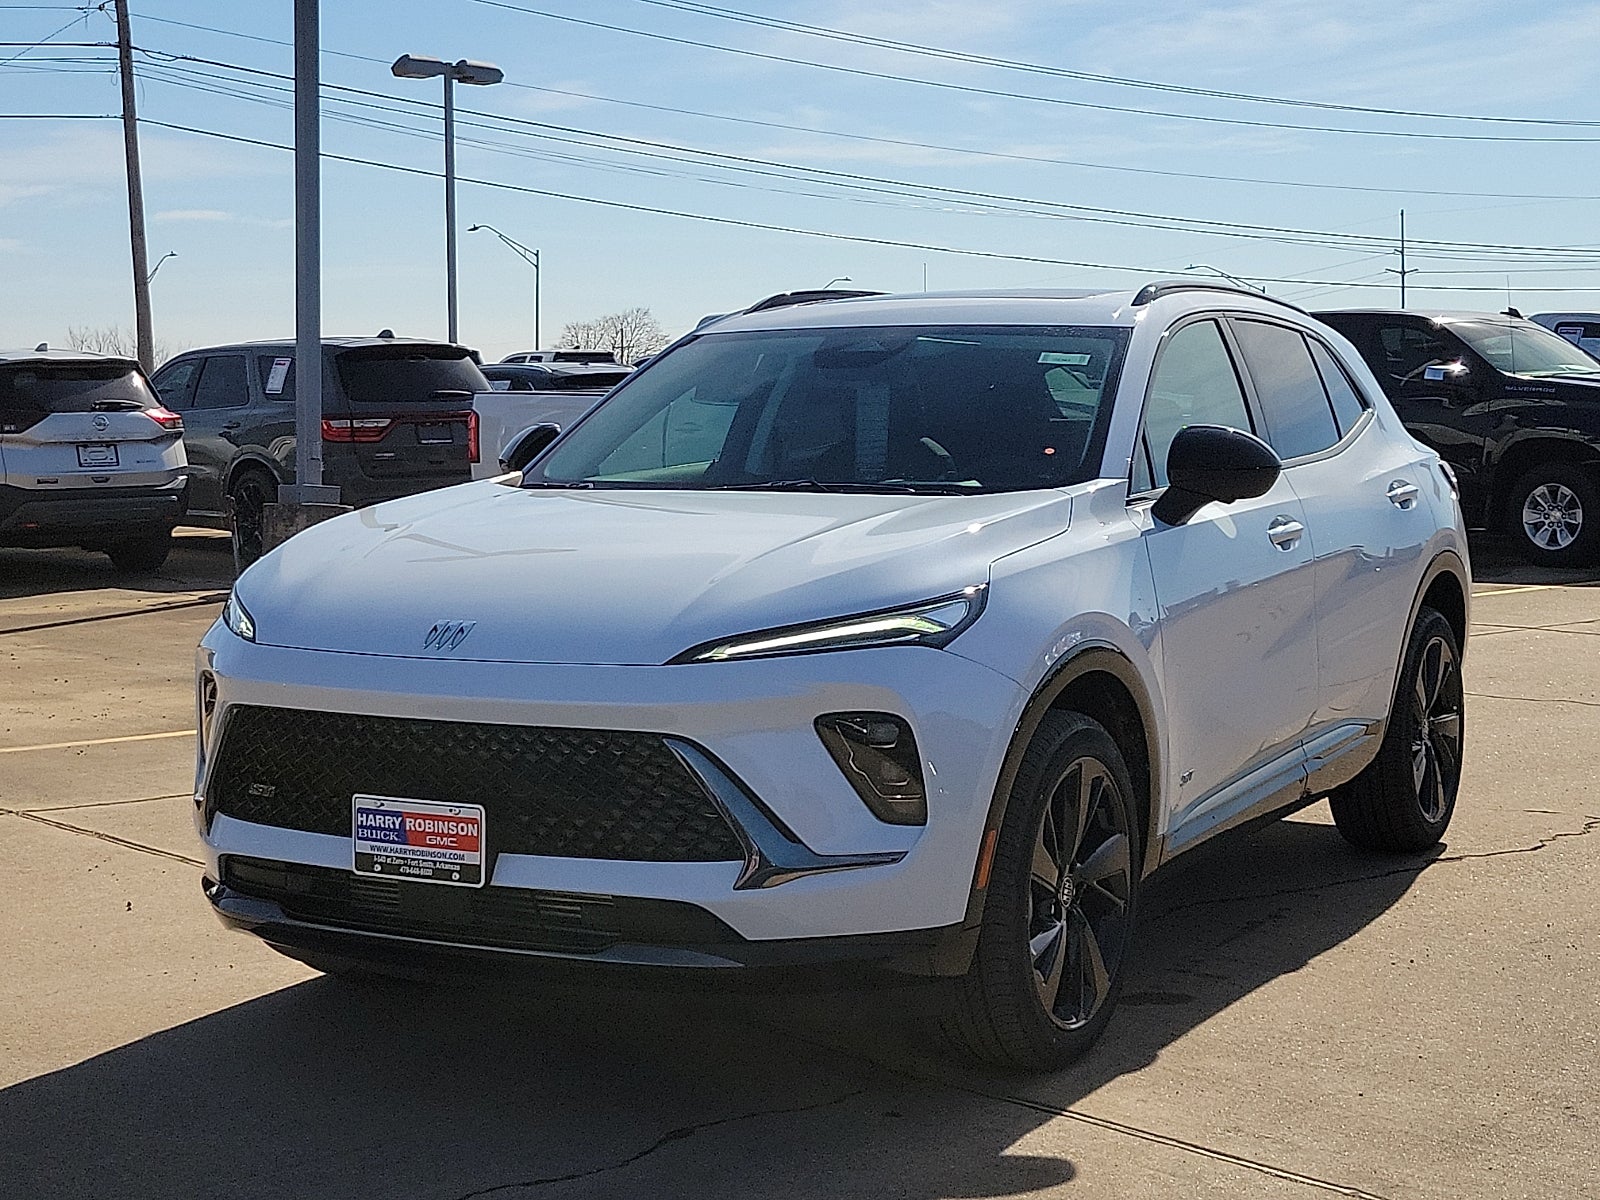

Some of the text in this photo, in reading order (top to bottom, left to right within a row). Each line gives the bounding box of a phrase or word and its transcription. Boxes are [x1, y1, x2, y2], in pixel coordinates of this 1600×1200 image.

[357, 812, 478, 837] HARRY ROBINSON
[357, 828, 459, 847] BUICK GMC
[369, 844, 466, 861] WWW.HARRYROBINSON.COM
[435, 861, 461, 871] Arkansas
